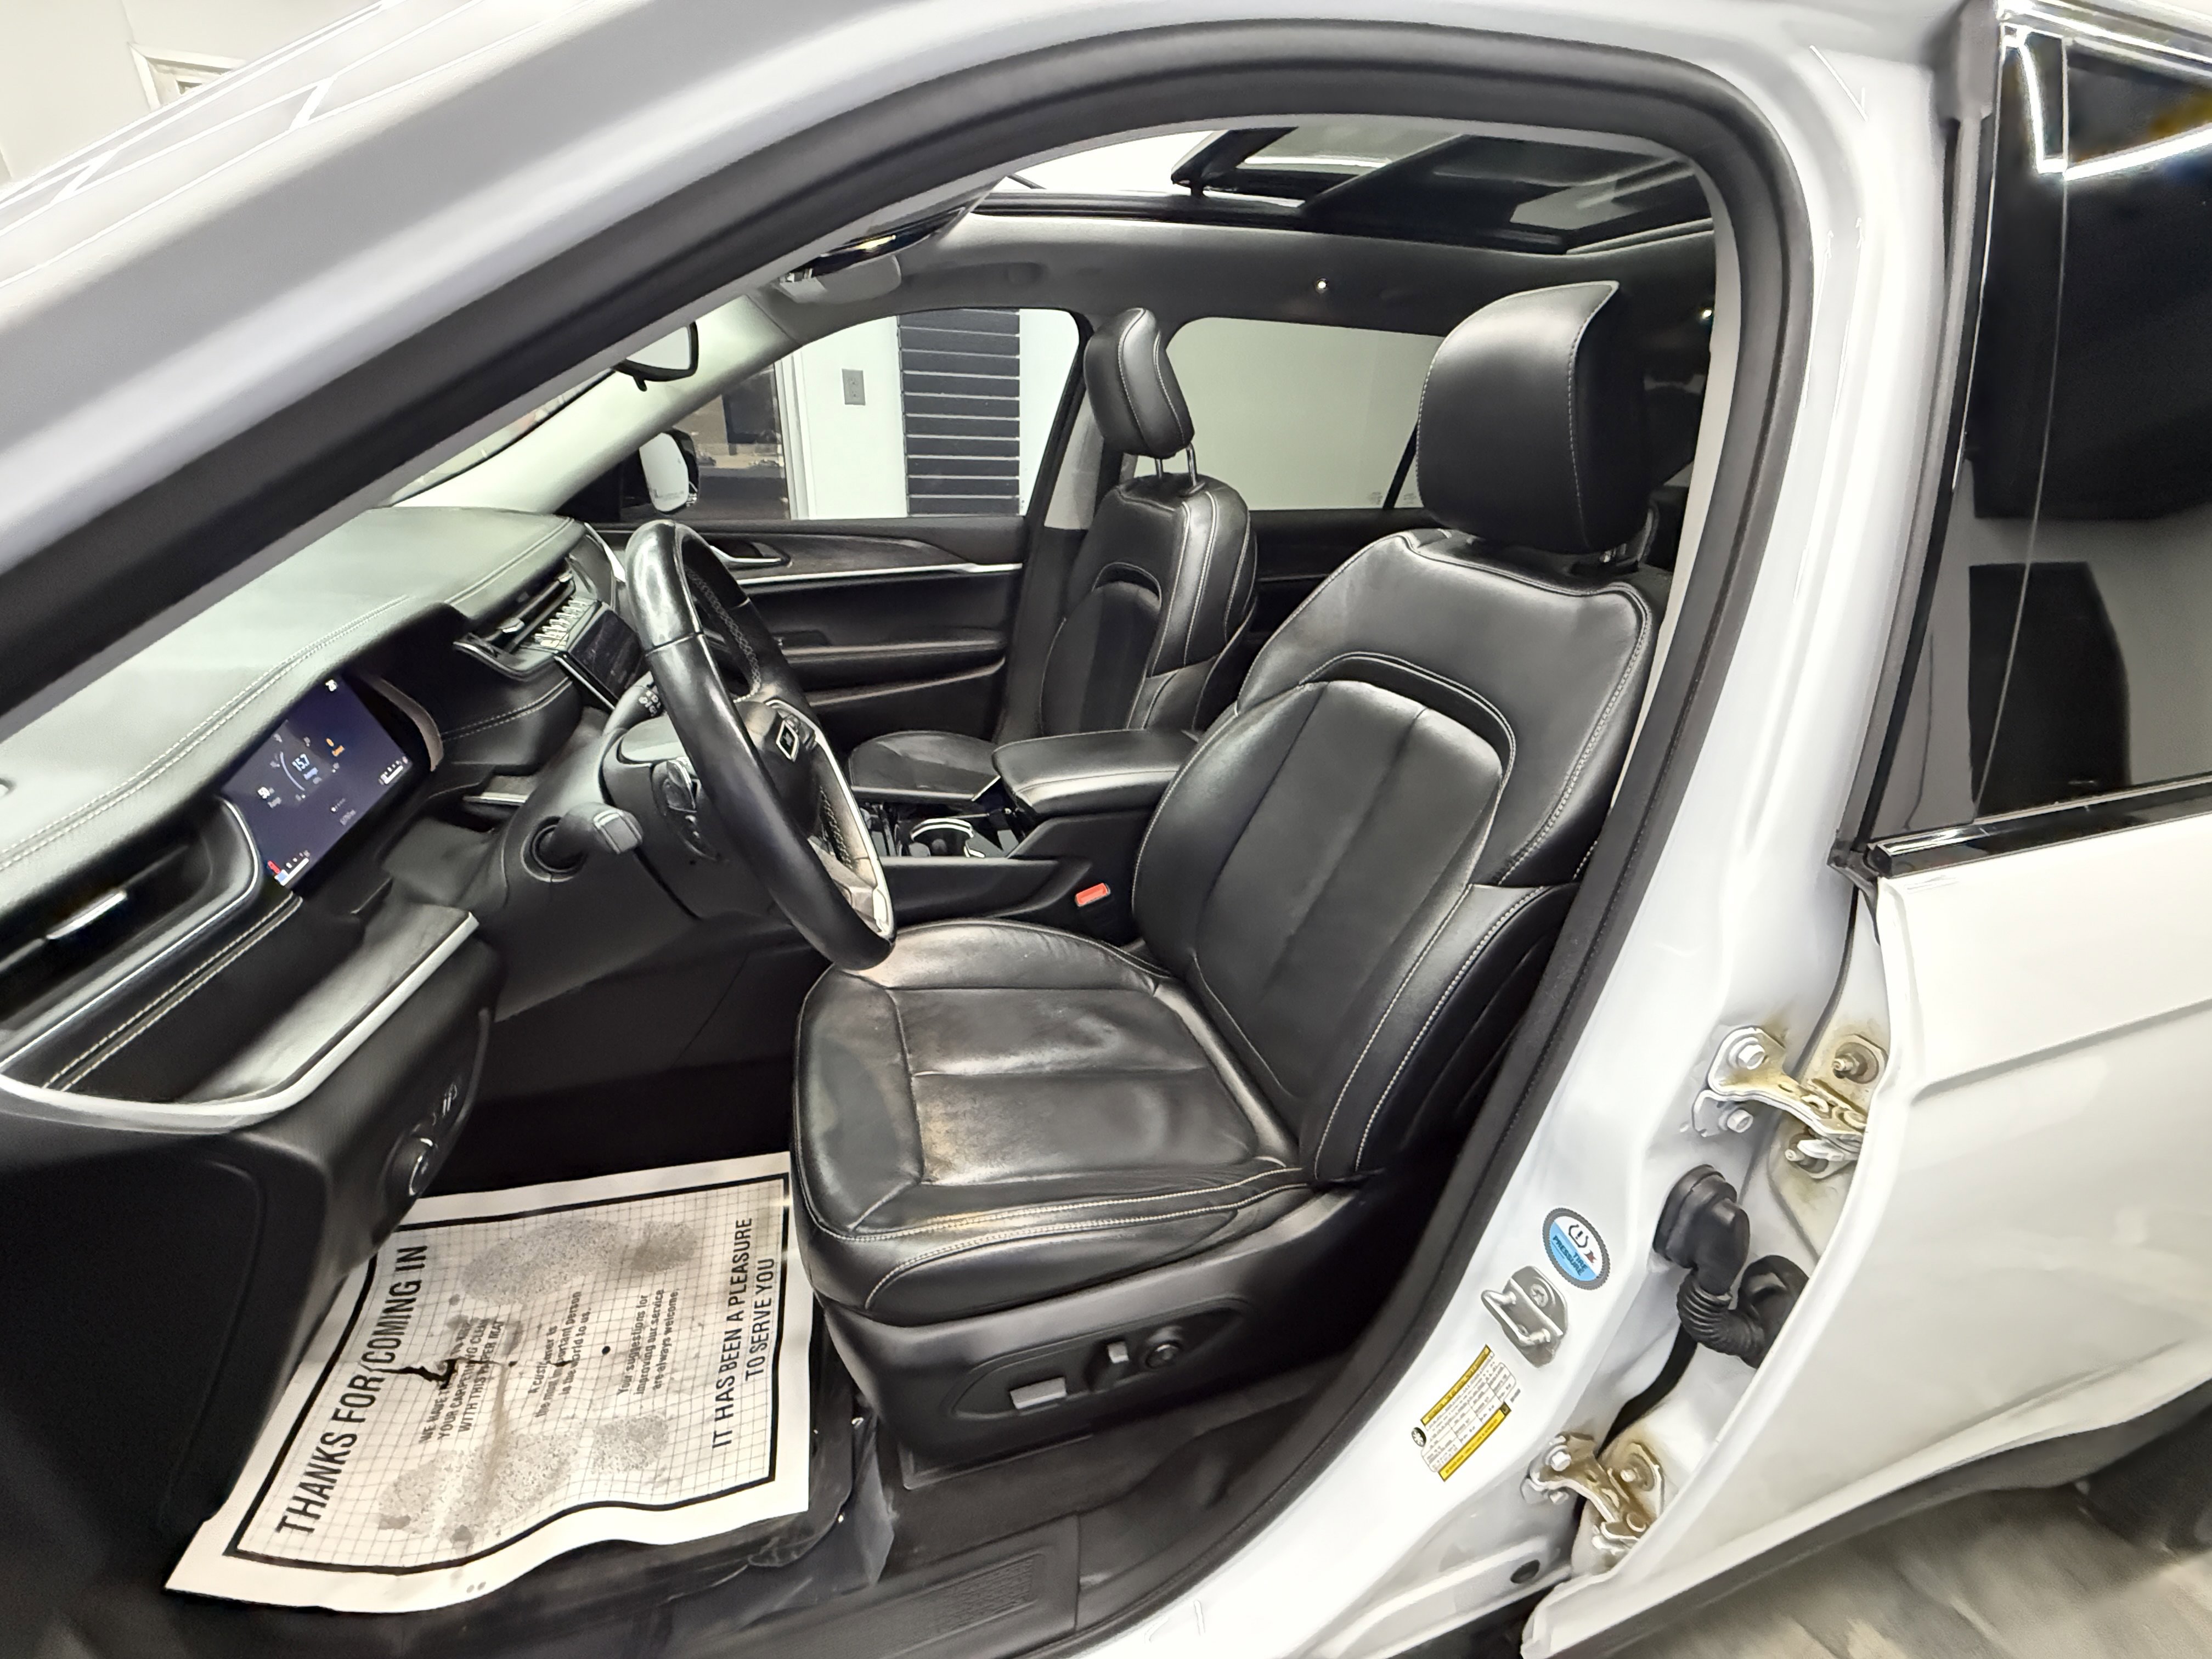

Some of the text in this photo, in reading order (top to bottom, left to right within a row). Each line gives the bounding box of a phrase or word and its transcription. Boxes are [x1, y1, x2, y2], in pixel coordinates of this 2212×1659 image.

[291, 753, 311, 772] 15.7
[1553, 1235, 1584, 1276] PRESSURE
[1573, 1251, 1588, 1270] TIRE
[565, 1291, 582, 1324] person
[746, 1259, 774, 1380] TO SERVE YOU
[575, 1327, 586, 1336] to
[617, 1295, 648, 1394] Your suggestions for
[633, 1289, 664, 1395] improving our service
[712, 1218, 752, 1448] IT HAS BEEN A PLEASURE
[458, 1403, 477, 1431] WITH
[470, 1377, 486, 1398] THIS
[488, 1319, 504, 1338] MAT
[656, 1337, 672, 1372] always
[275, 1245, 427, 1534] THANKS FOR COMING IN
[437, 1410, 458, 1439] YOUR
[450, 1347, 477, 1407] CARPETING
[470, 1319, 489, 1342] CLEAN
[652, 1374, 663, 1389] are
[419, 1426, 435, 1442] WE
[427, 1397, 447, 1421] HAVE
